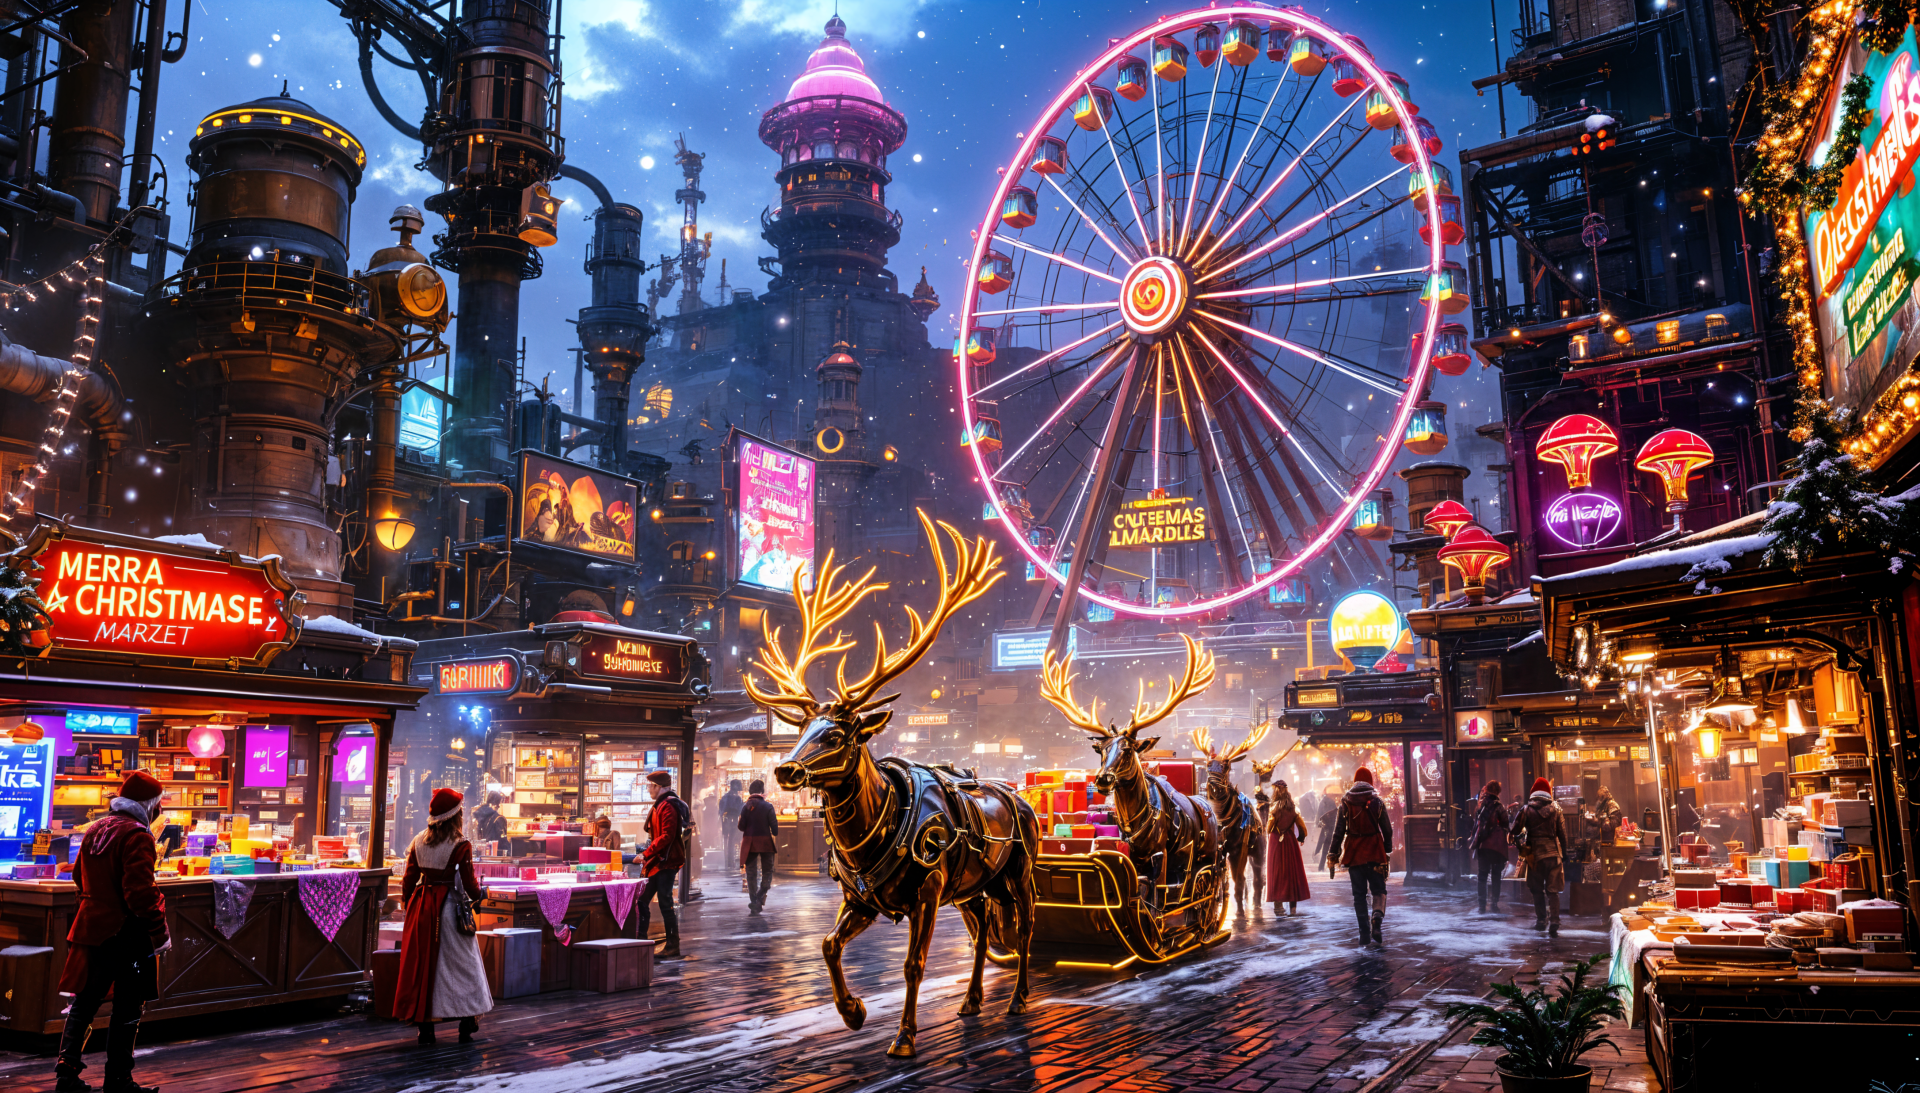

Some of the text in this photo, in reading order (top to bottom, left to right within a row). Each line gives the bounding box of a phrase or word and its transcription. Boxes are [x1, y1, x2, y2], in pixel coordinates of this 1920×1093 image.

[58, 551, 164, 585] MERRA
[75, 584, 263, 625] CHRISTMASE
[94, 621, 194, 645] MARZET
